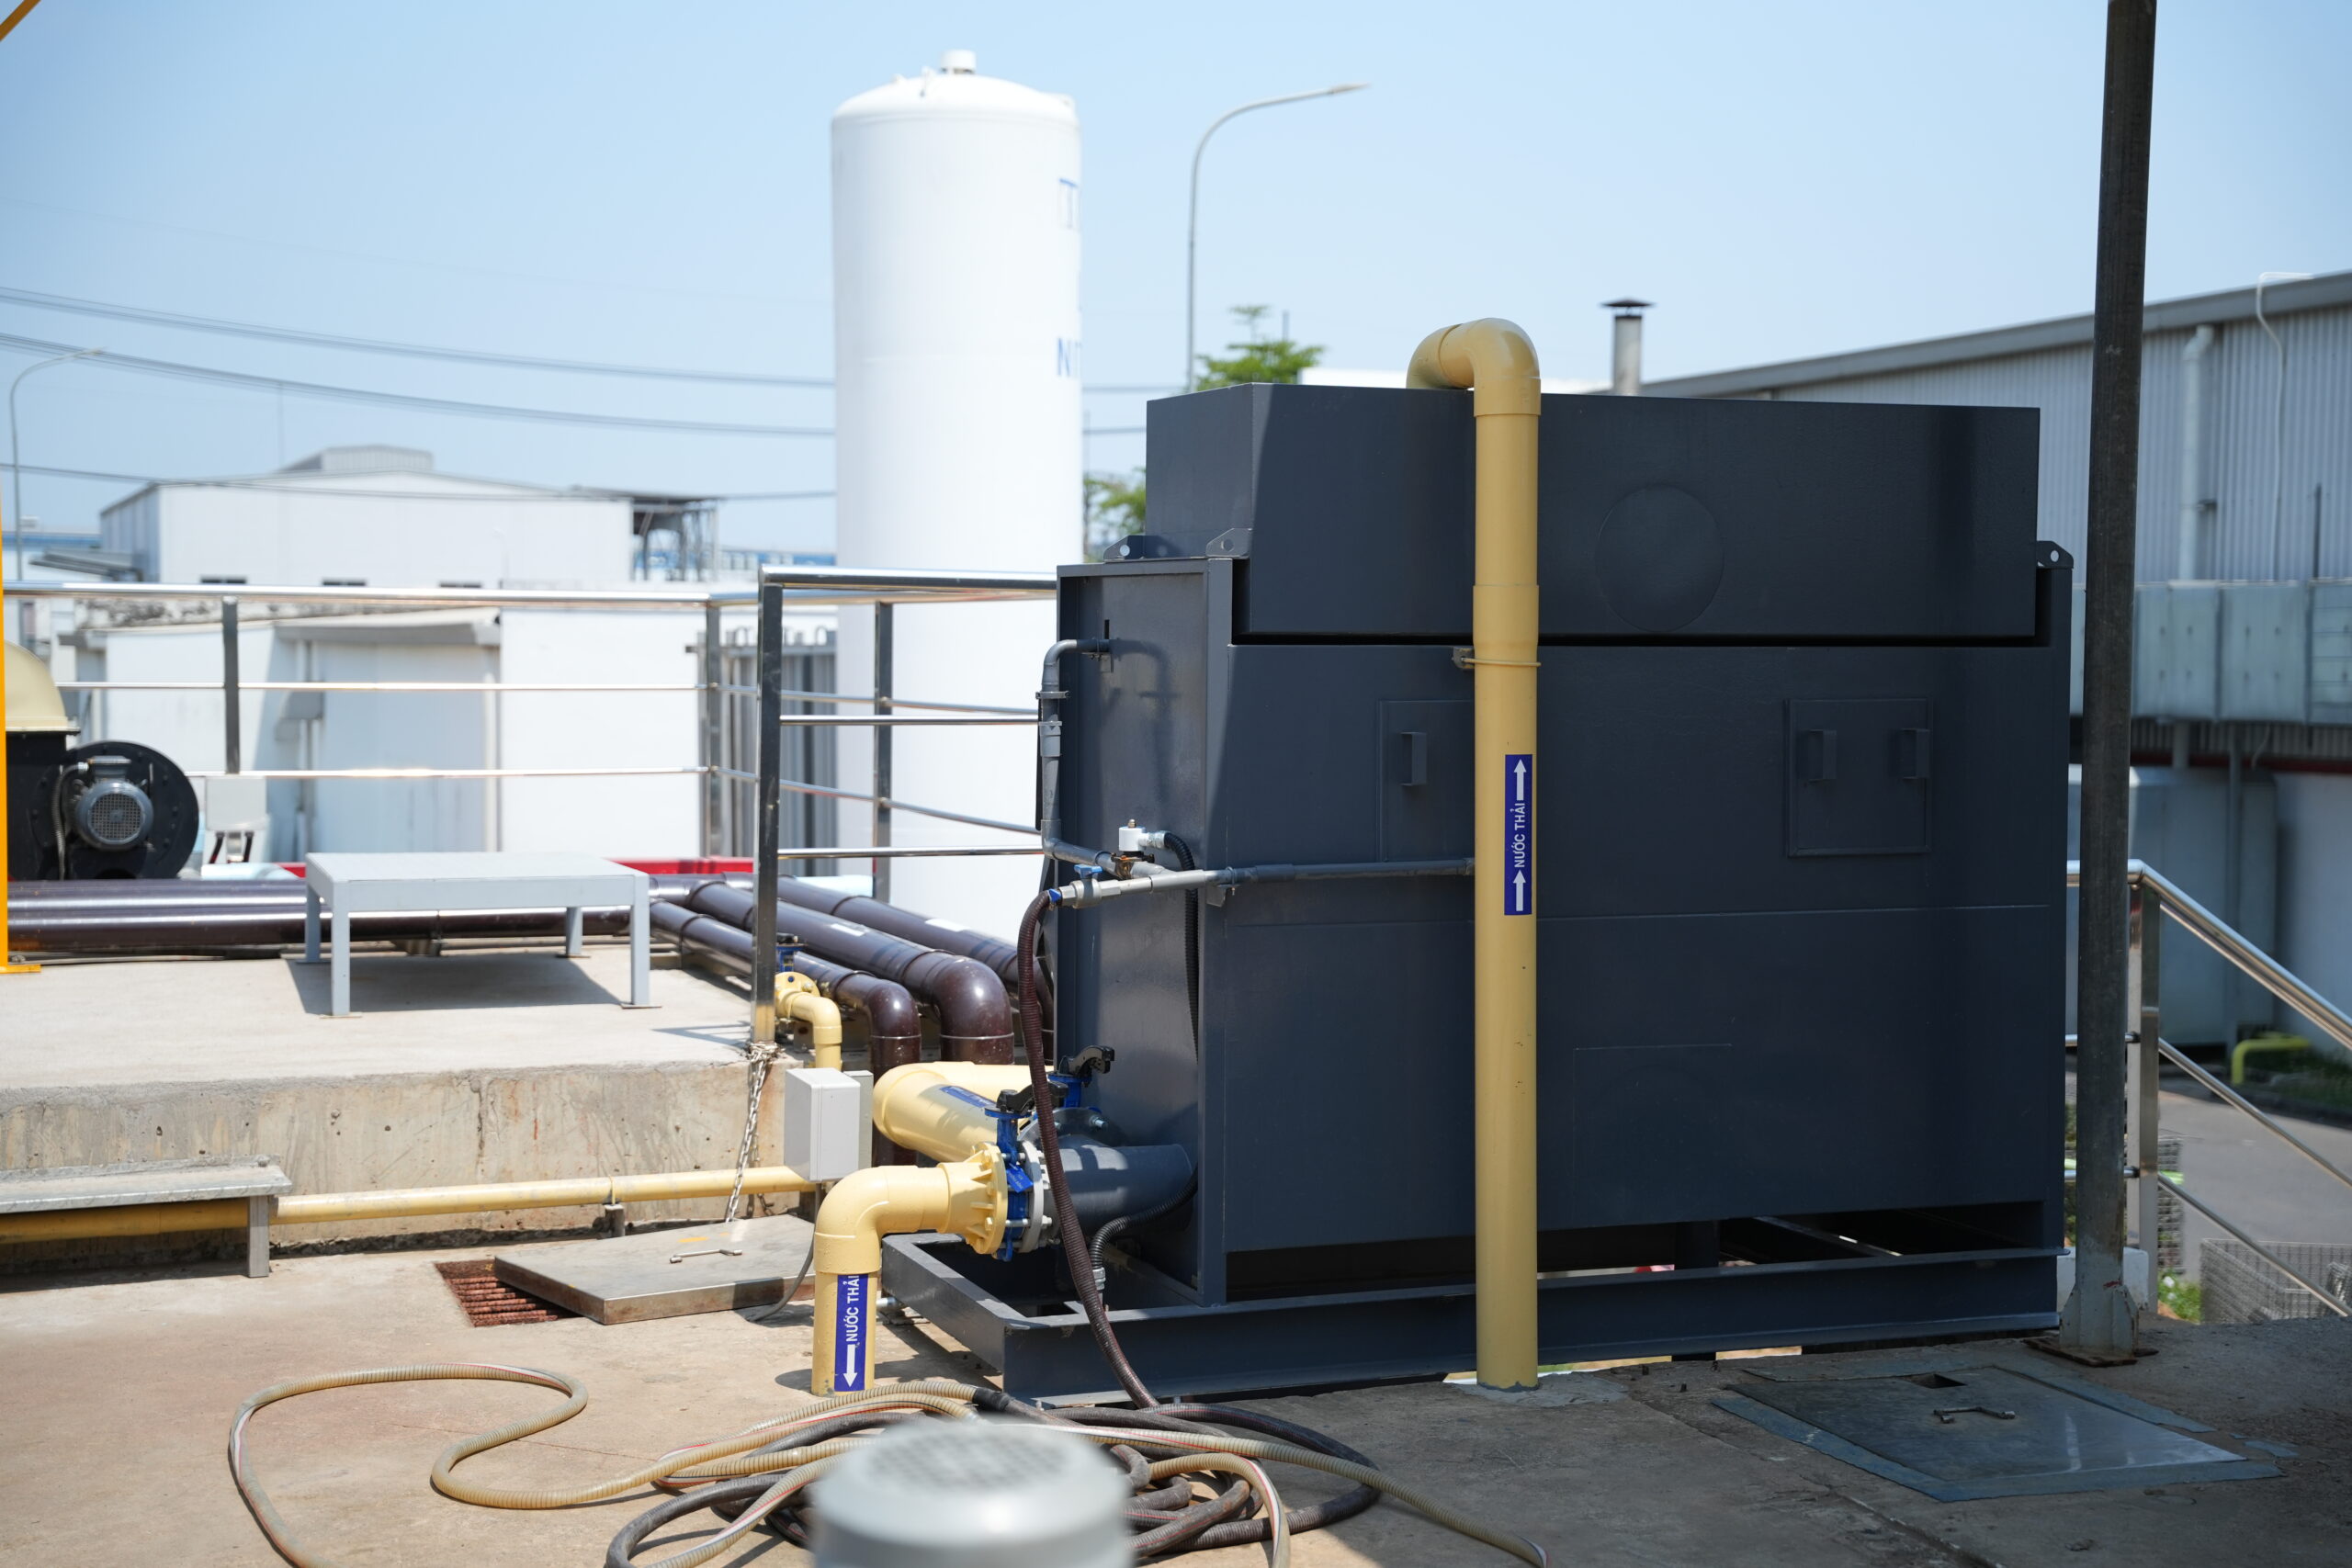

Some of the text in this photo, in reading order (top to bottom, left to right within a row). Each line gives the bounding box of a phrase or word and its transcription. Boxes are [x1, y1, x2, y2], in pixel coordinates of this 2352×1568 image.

[1510, 802, 1526, 868] NƯỚC THẢI
[842, 1275, 860, 1342] NƯỚC THẢI
